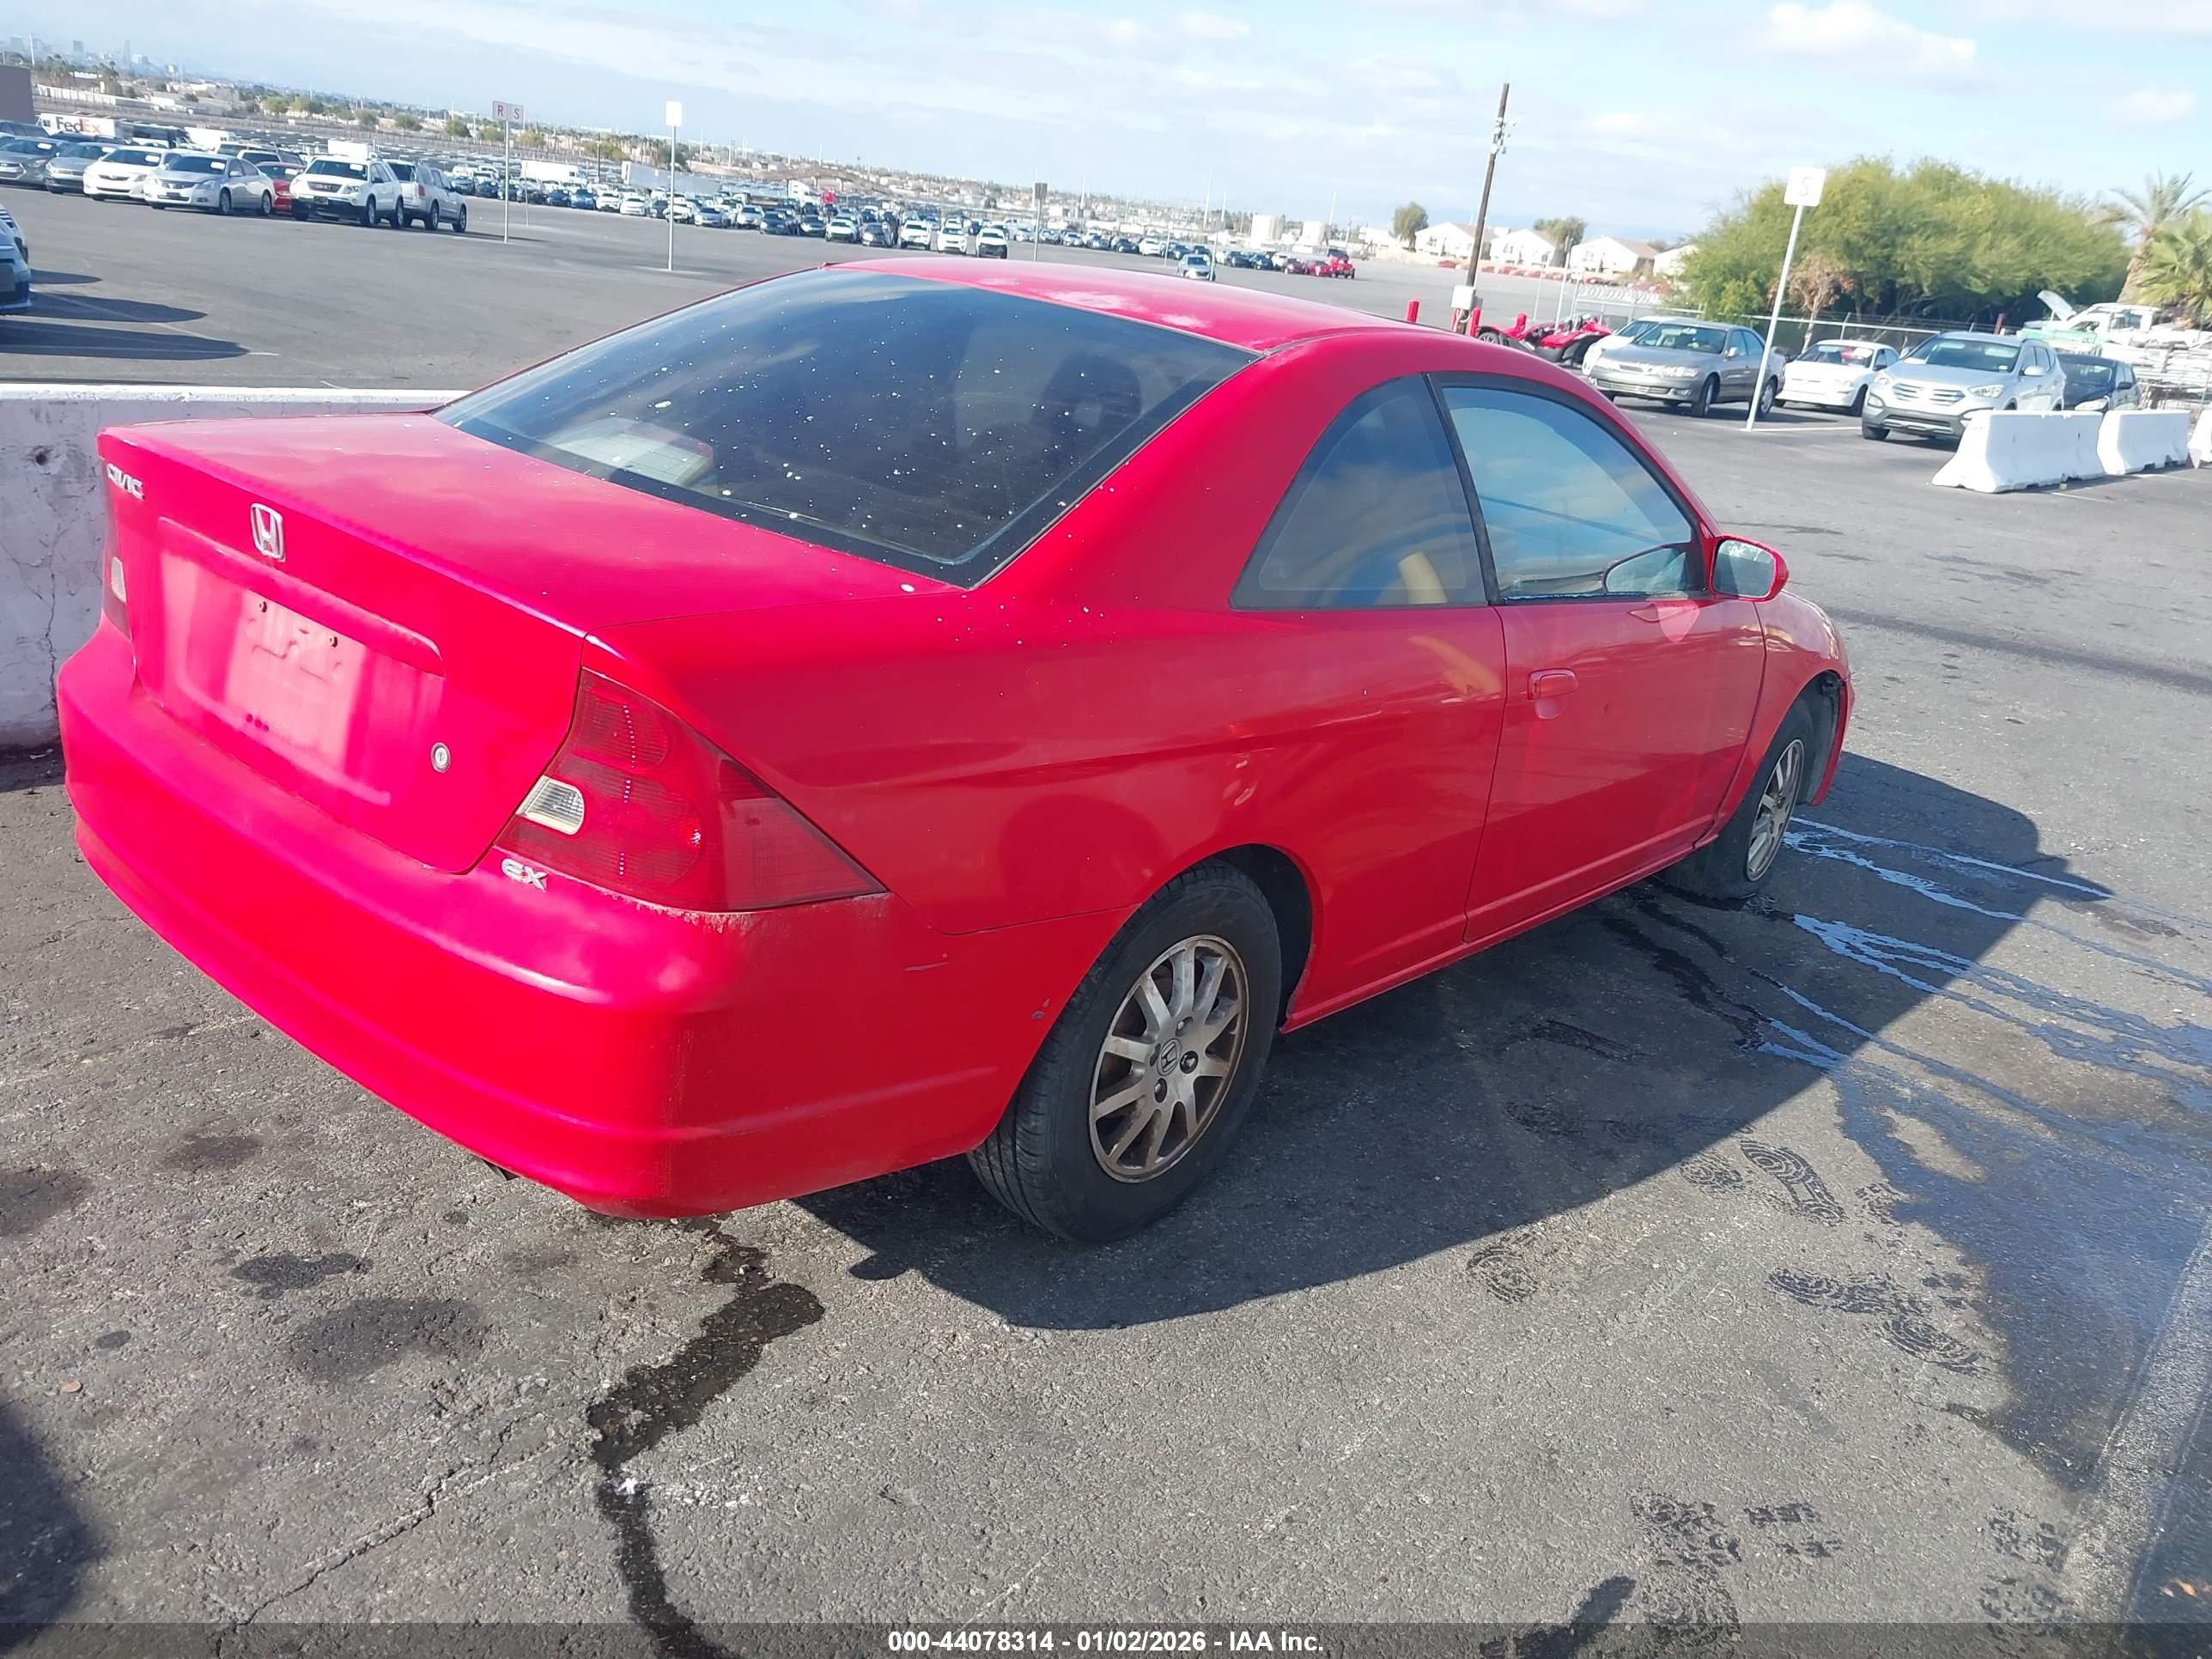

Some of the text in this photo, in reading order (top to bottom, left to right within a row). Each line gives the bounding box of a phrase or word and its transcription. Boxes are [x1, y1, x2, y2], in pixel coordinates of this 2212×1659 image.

[497, 104, 520, 119] R S
[56, 116, 100, 133] FedEx
[1798, 176, 1812, 197] S
[106, 463, 145, 501] CIVIC
[501, 858, 548, 891] EX
